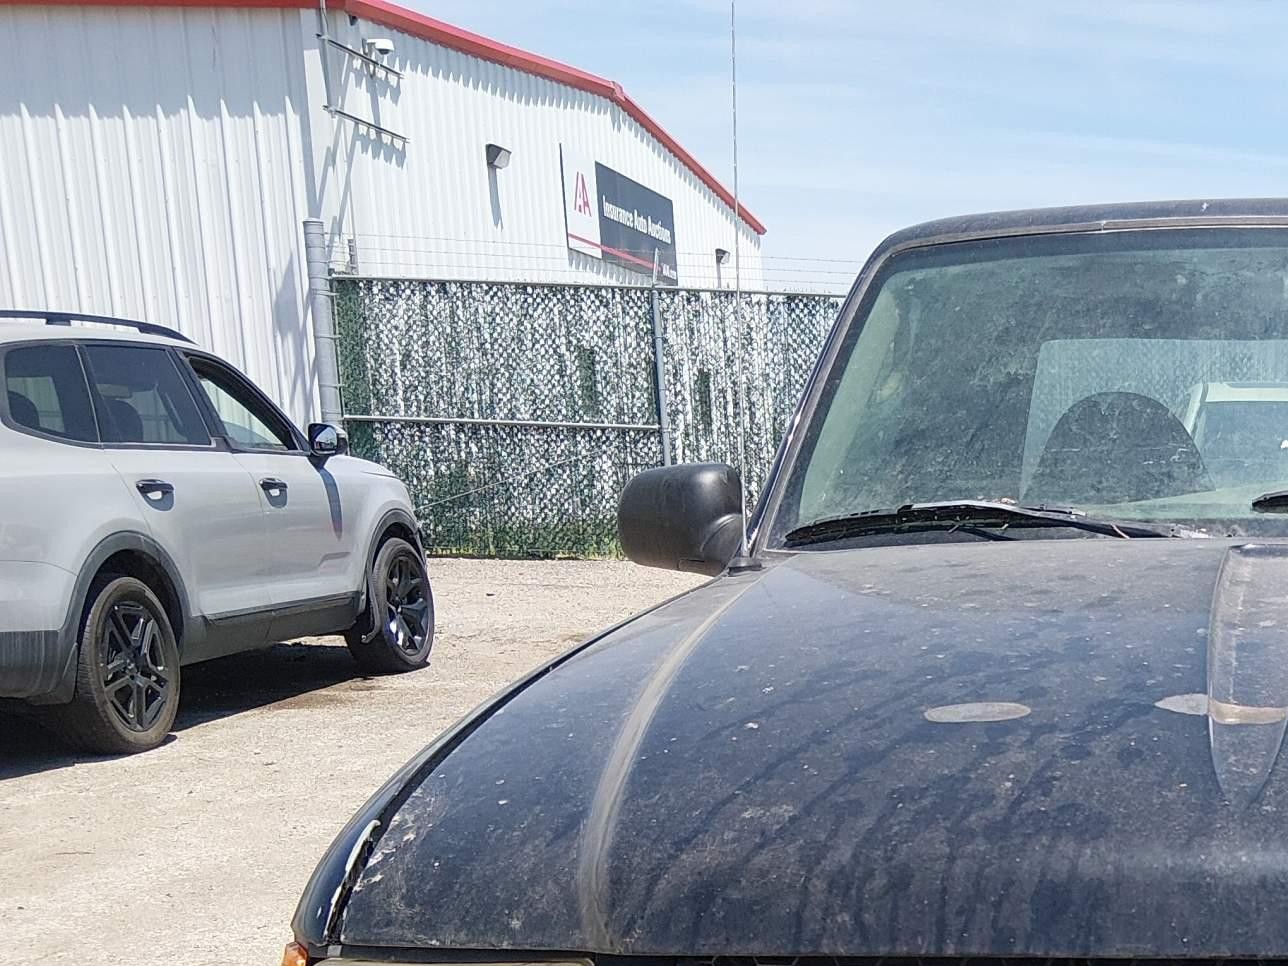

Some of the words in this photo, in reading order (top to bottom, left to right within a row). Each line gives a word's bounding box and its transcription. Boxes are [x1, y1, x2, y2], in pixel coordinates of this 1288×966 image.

[602, 194, 633, 228] Insurance
[633, 208, 648, 234] Auto
[647, 215, 671, 244] Auctions
